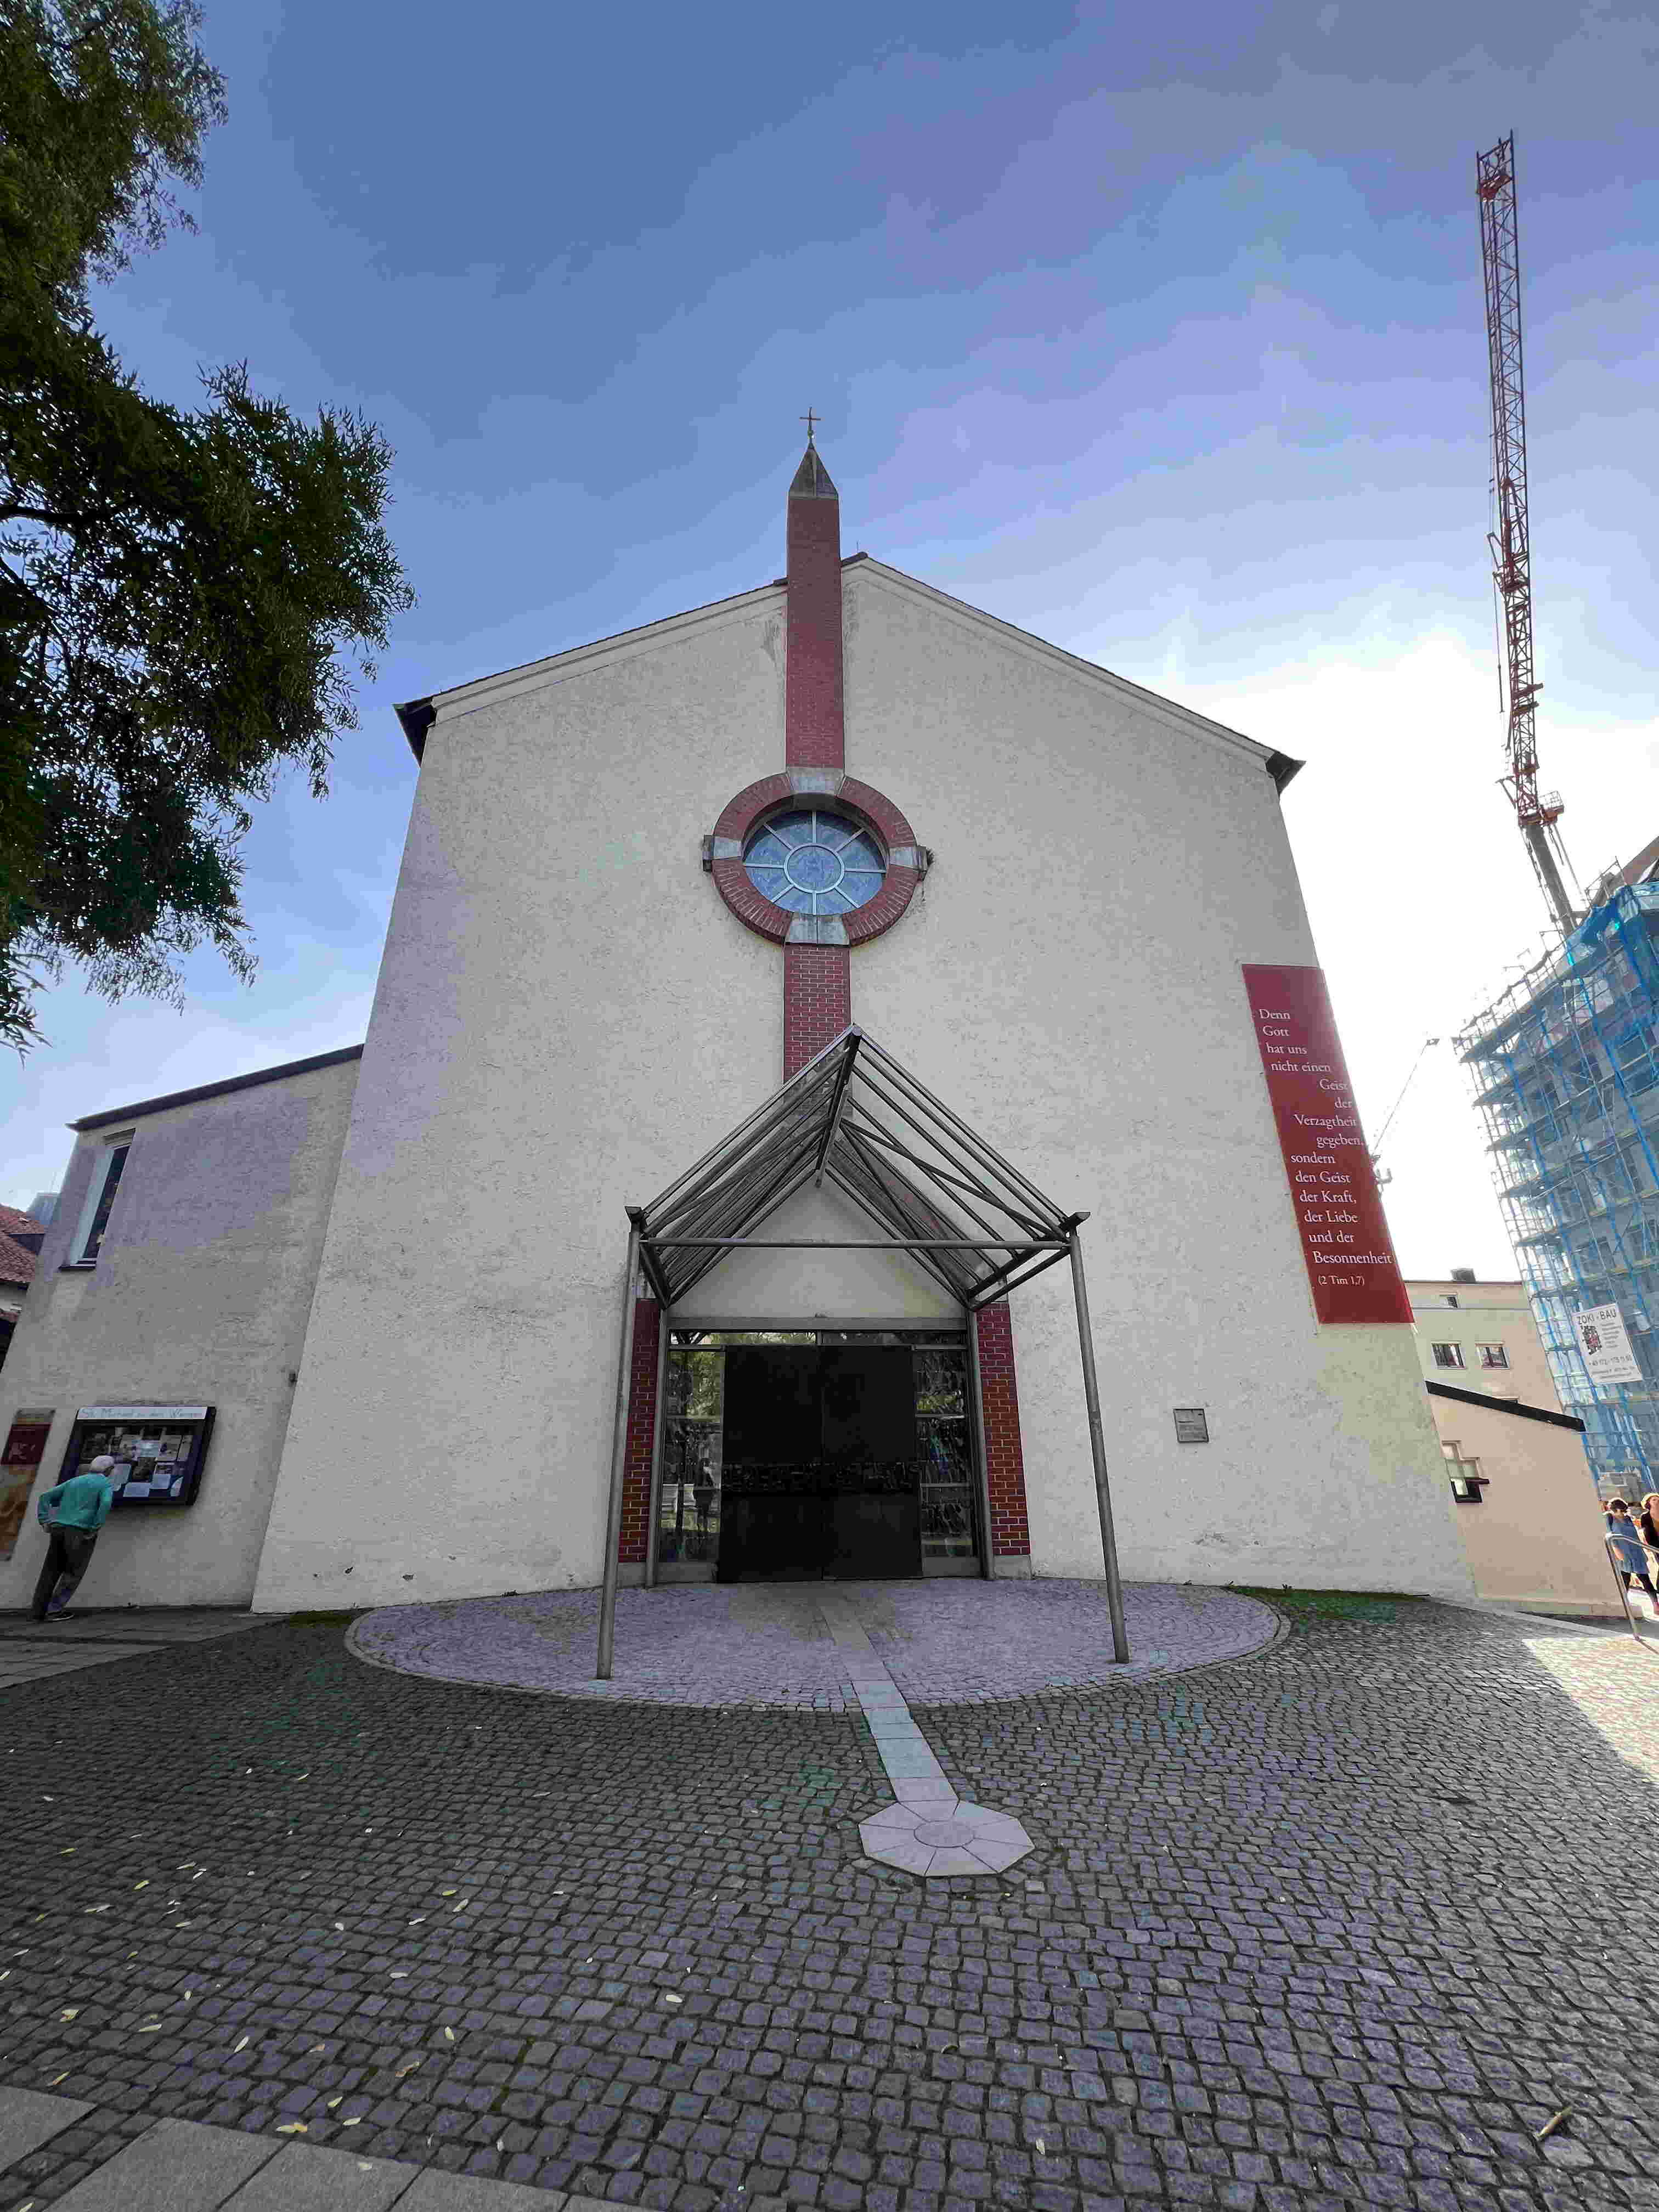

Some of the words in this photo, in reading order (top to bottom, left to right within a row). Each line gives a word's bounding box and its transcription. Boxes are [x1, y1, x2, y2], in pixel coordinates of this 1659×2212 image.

[1259, 1009, 1290, 1019] Denn
[1263, 1026, 1289, 1036] Gott
[1266, 1043, 1284, 1053] hat
[1288, 1045, 1307, 1054] uns
[1271, 1060, 1299, 1071] nicht
[1301, 1062, 1330, 1071] einen
[1319, 1079, 1347, 1090] Geist
[1334, 1097, 1352, 1108] der
[1294, 1114, 1356, 1129] Verzagtheit
[1290, 1152, 1335, 1164] sondern
[1295, 1171, 1317, 1183] den
[1320, 1171, 1351, 1183] Geist
[1299, 1190, 1318, 1202] der
[1321, 1190, 1357, 1204] Kraft,
[1304, 1210, 1323, 1222] der
[1326, 1210, 1358, 1223] Liebe
[1308, 1231, 1333, 1243] und
[1336, 1230, 1355, 1243] der
[1318, 1274, 1327, 1286] (2
[1328, 1275, 1348, 1285] Tim
[1600, 1309, 1617, 1320] BAU
